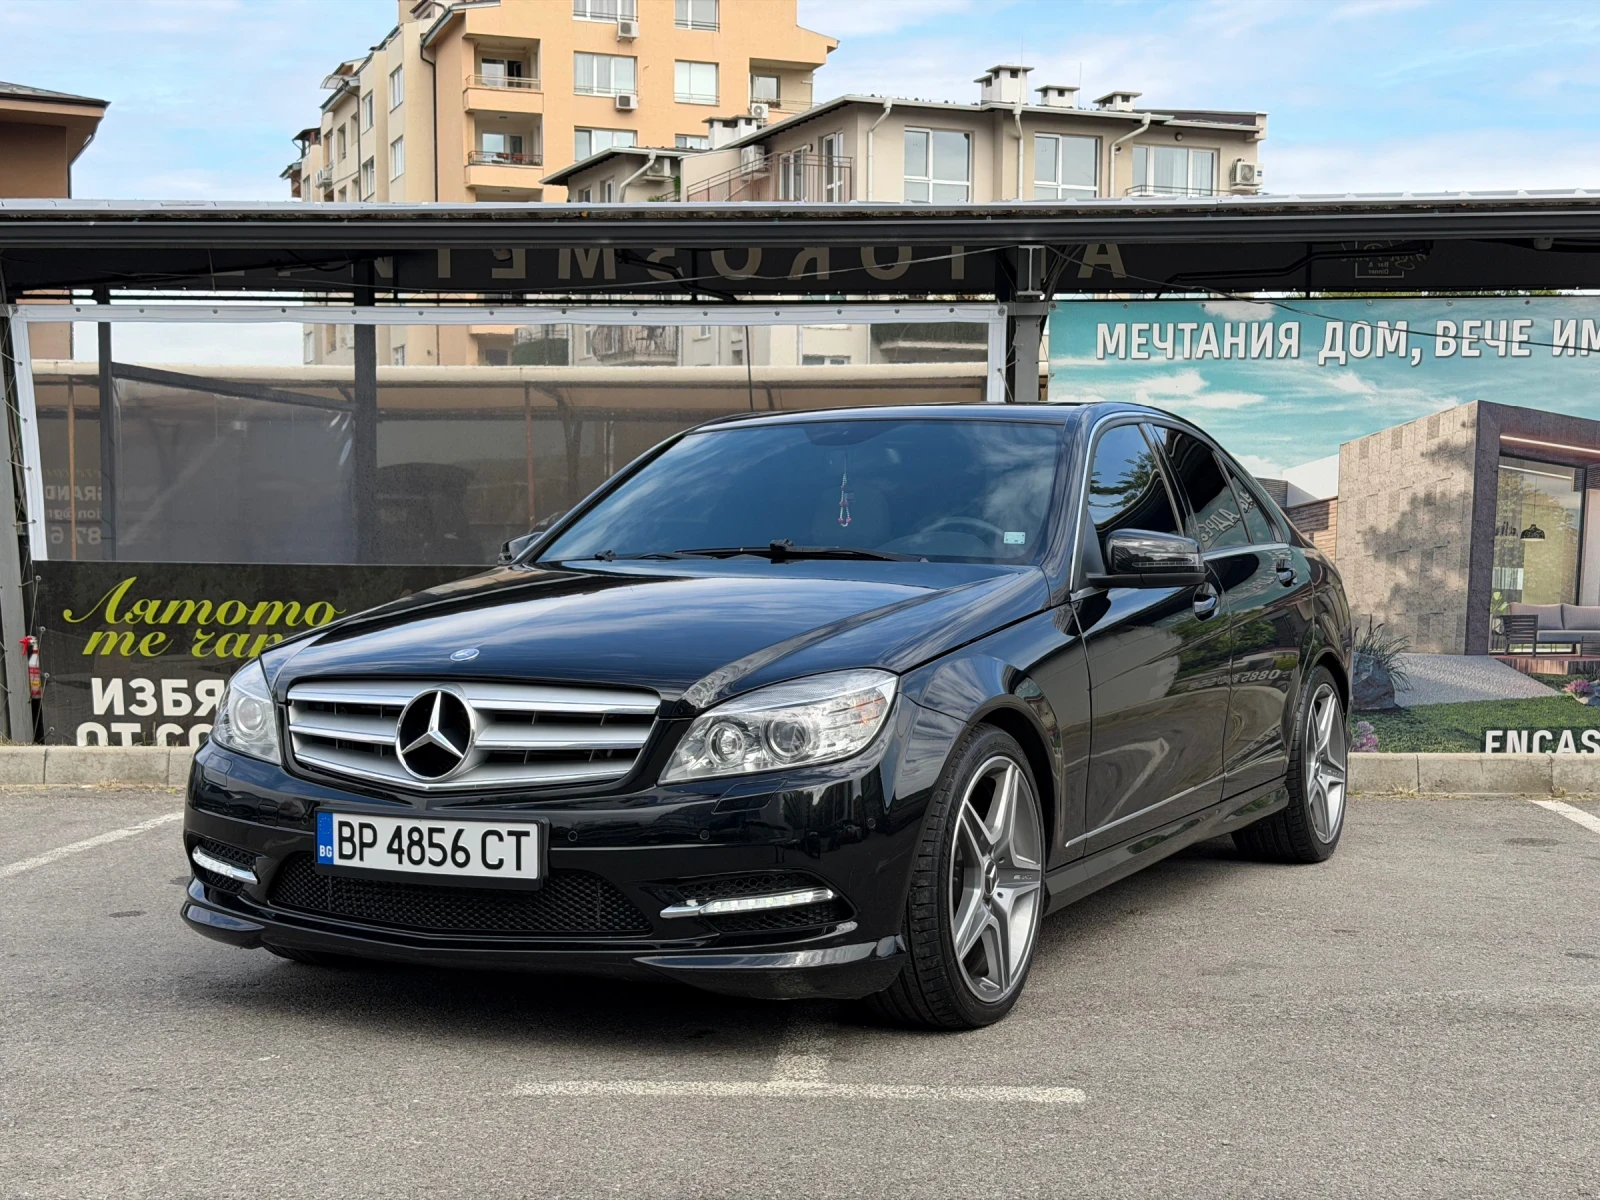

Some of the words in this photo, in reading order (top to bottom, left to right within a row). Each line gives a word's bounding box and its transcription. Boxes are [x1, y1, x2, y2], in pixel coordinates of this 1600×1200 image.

[1096, 321, 1301, 360] МЕЧТАНИЯ
[1317, 320, 1422, 366] ДОМ,
[1434, 319, 1532, 357] ВЕЧЕ
[63, 576, 346, 627] Лятото
[82, 630, 174, 657] те
[319, 845, 333, 858] BG
[337, 820, 378, 862] BP
[386, 825, 471, 868] 4856
[481, 830, 531, 872] CT
